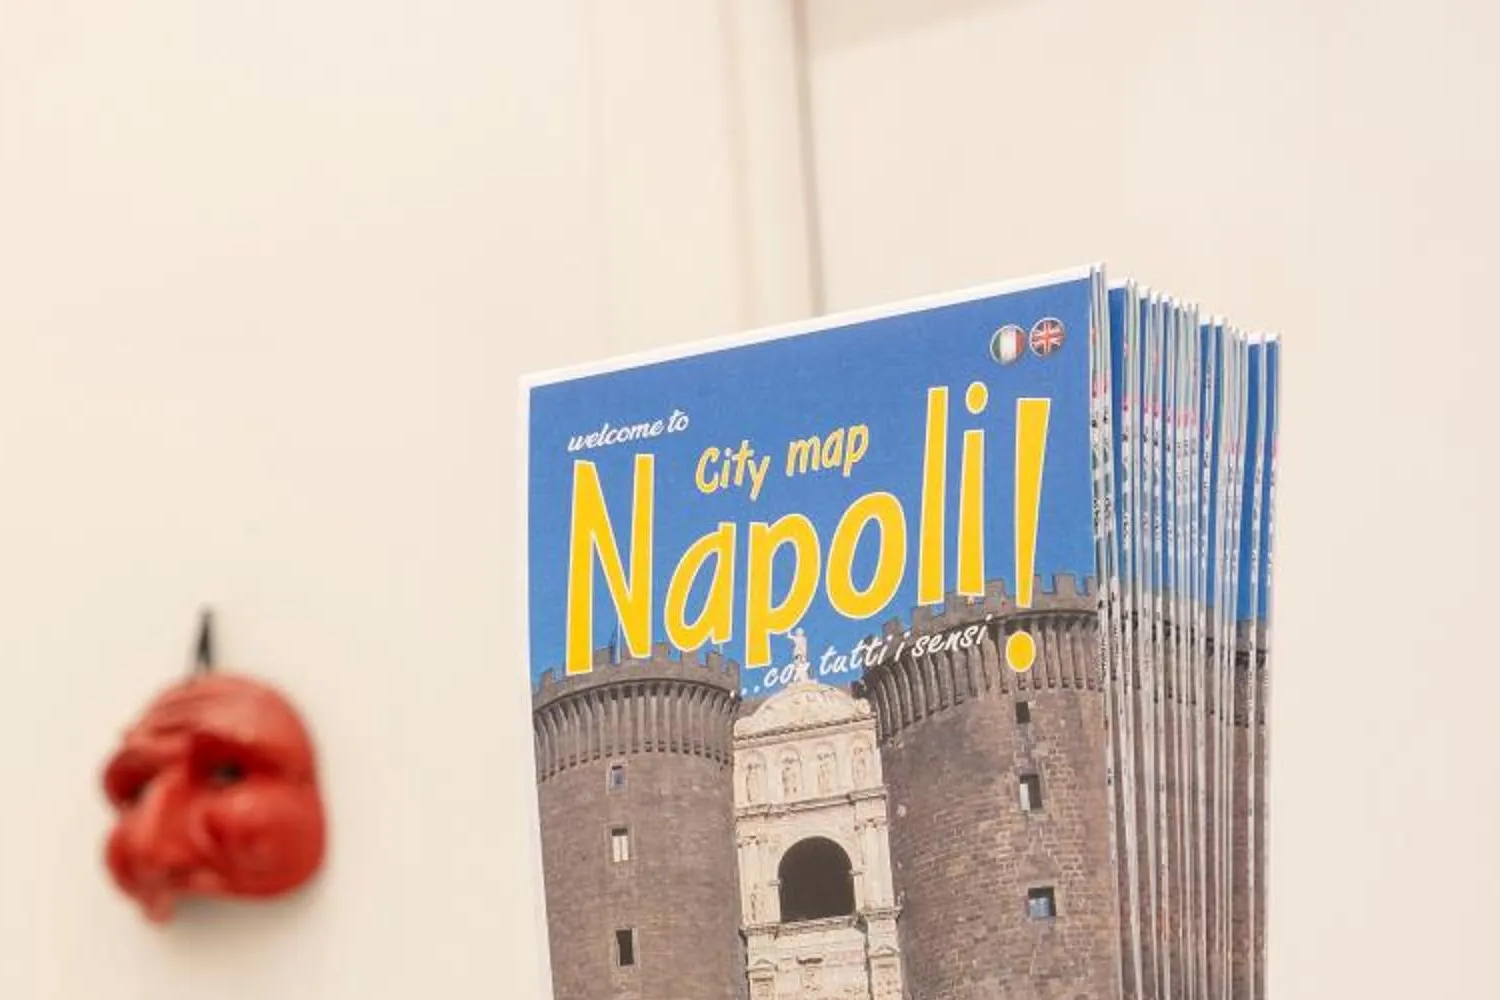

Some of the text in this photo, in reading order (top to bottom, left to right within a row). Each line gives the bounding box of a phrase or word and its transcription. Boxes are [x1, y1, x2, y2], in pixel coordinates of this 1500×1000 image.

[568, 409, 689, 452] welcome to
[695, 423, 869, 501] City map
[565, 381, 1052, 675] Napoli!
[819, 634, 893, 677] tutti
[894, 630, 912, 663] i
[911, 613, 994, 658] sensi
